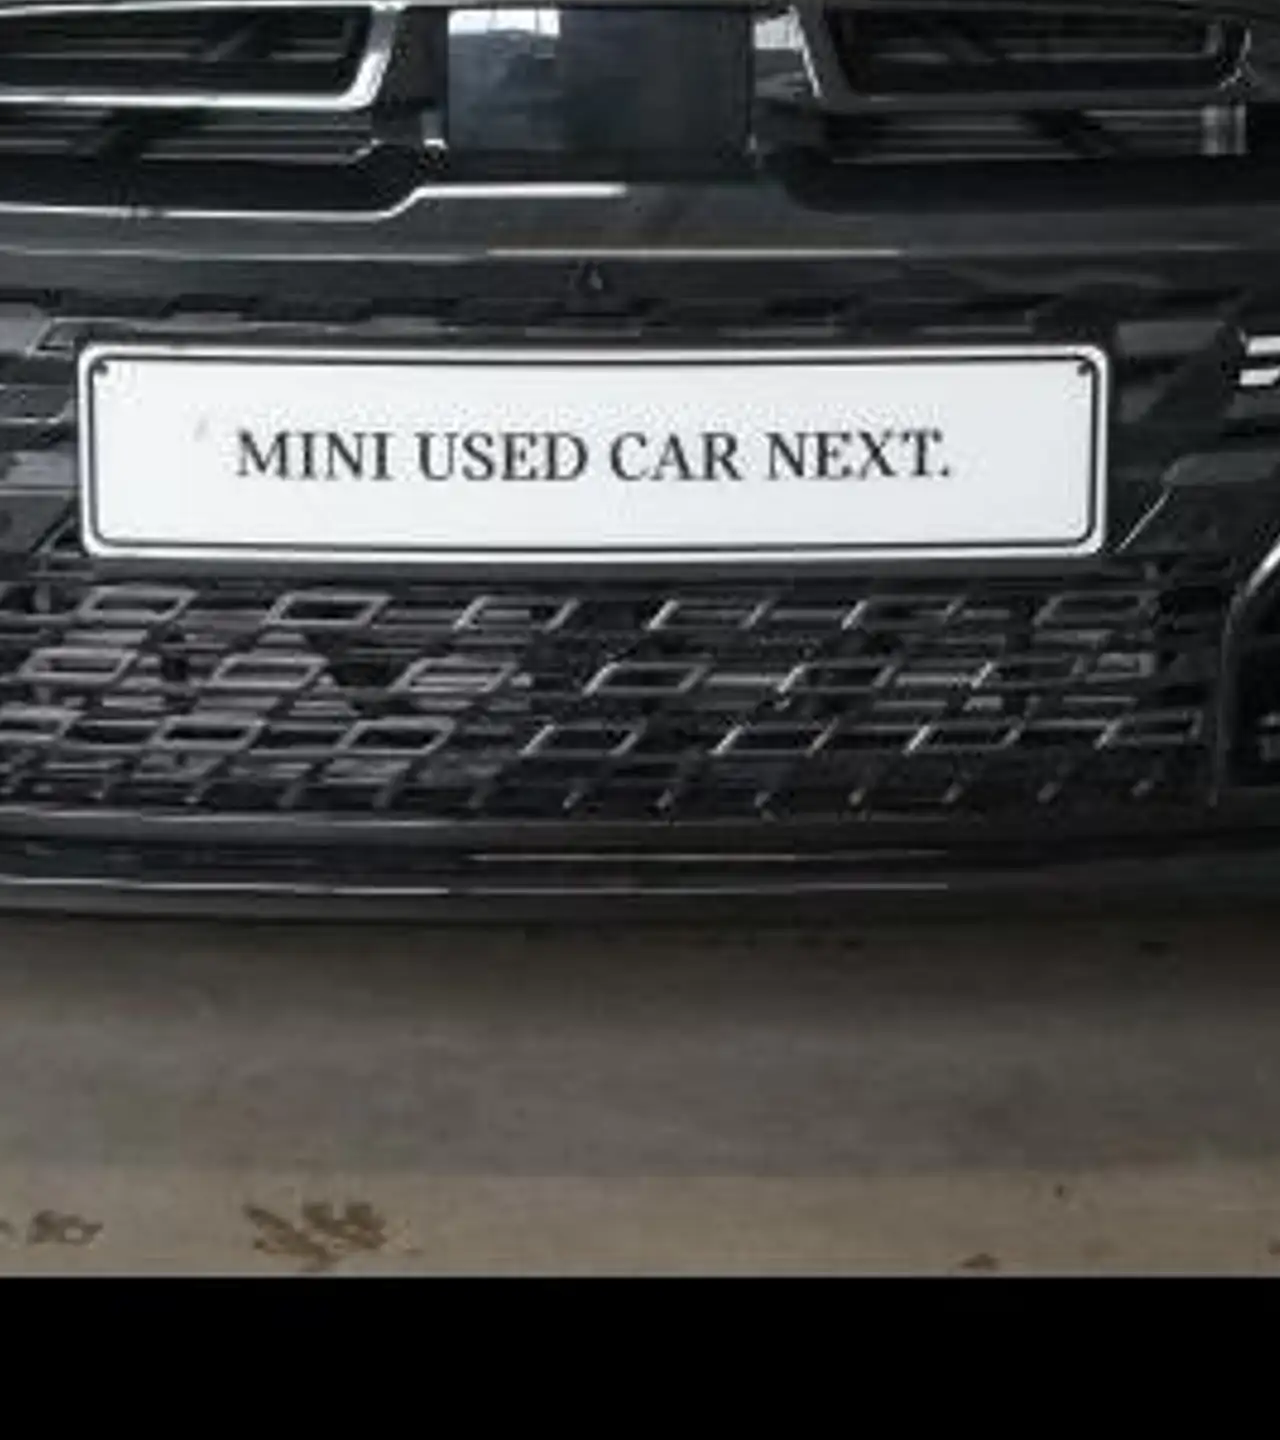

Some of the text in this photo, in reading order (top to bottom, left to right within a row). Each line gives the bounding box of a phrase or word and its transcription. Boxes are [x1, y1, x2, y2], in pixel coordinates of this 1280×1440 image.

[236, 428, 951, 481] MINI USED CAR NEXT.
